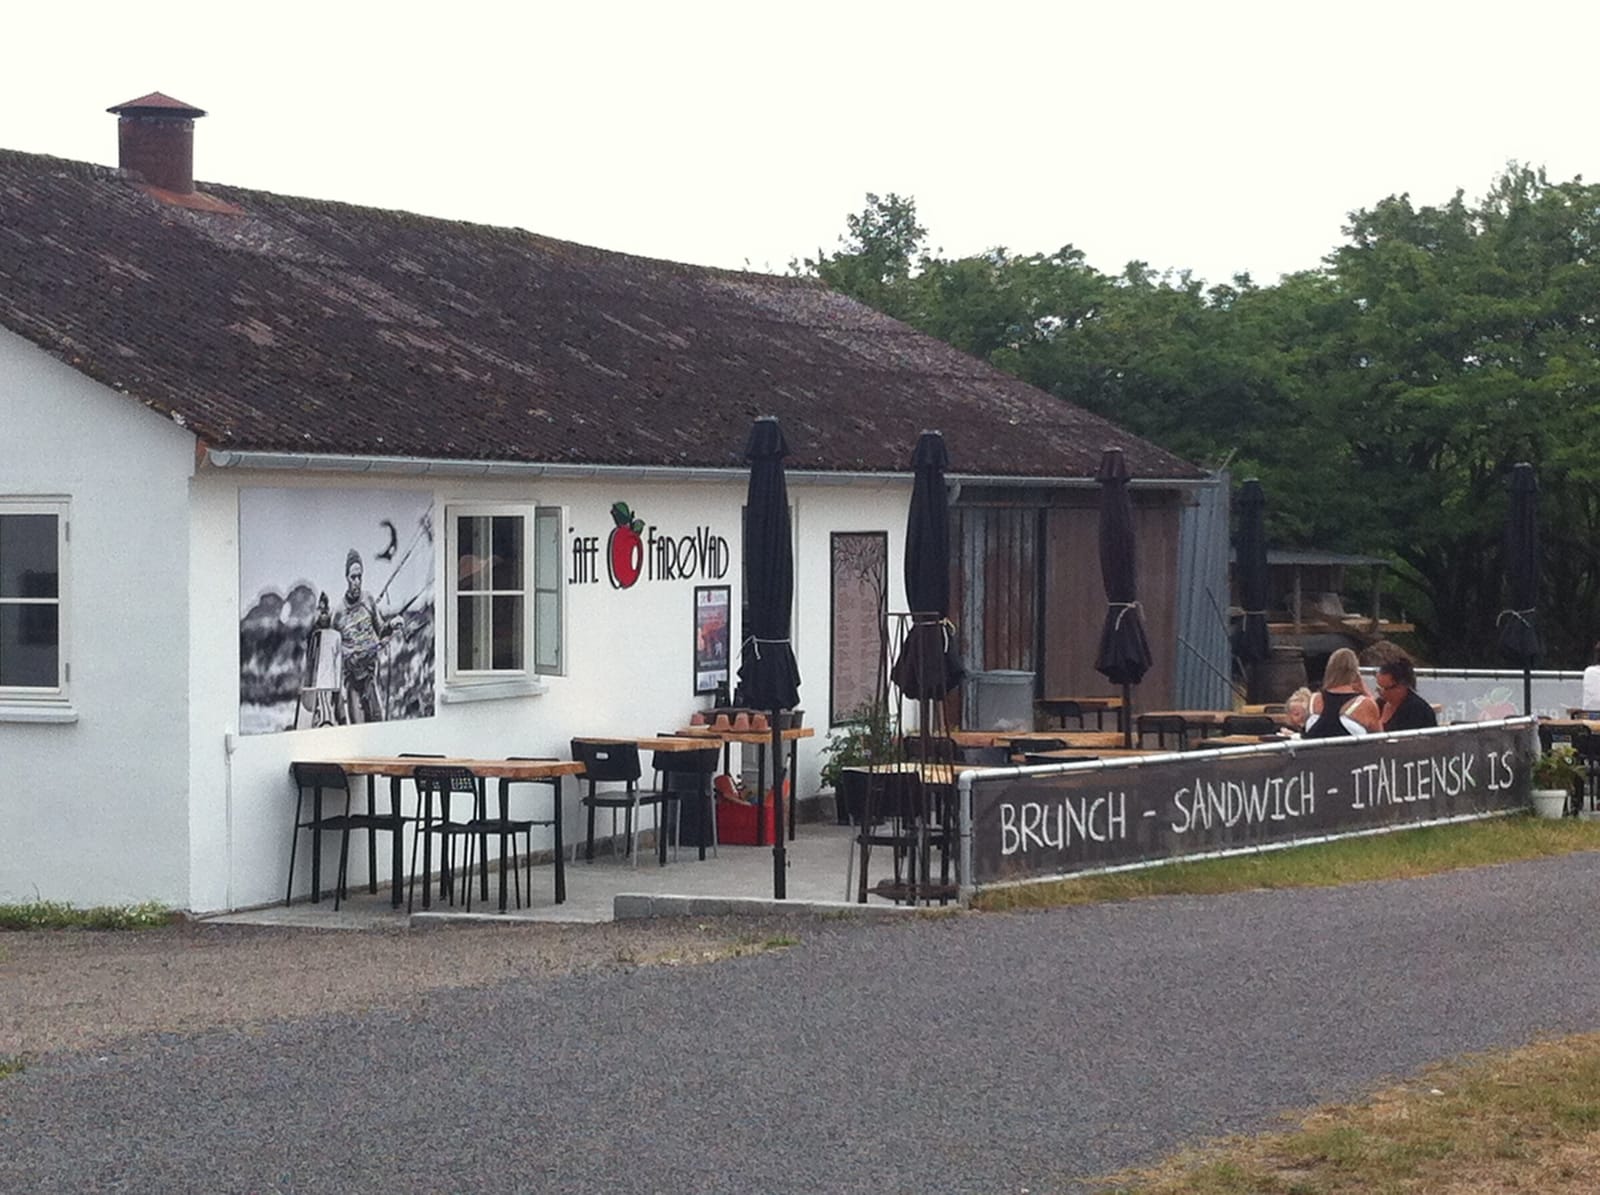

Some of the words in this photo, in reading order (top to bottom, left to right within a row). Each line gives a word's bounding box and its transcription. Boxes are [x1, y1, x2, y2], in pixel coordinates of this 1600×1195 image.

[1000, 791, 1127, 856] BRUNCH
[1171, 771, 1315, 834] SANDWICH
[1351, 751, 1477, 809] ITALIENSK
[1487, 750, 1515, 791] IS
